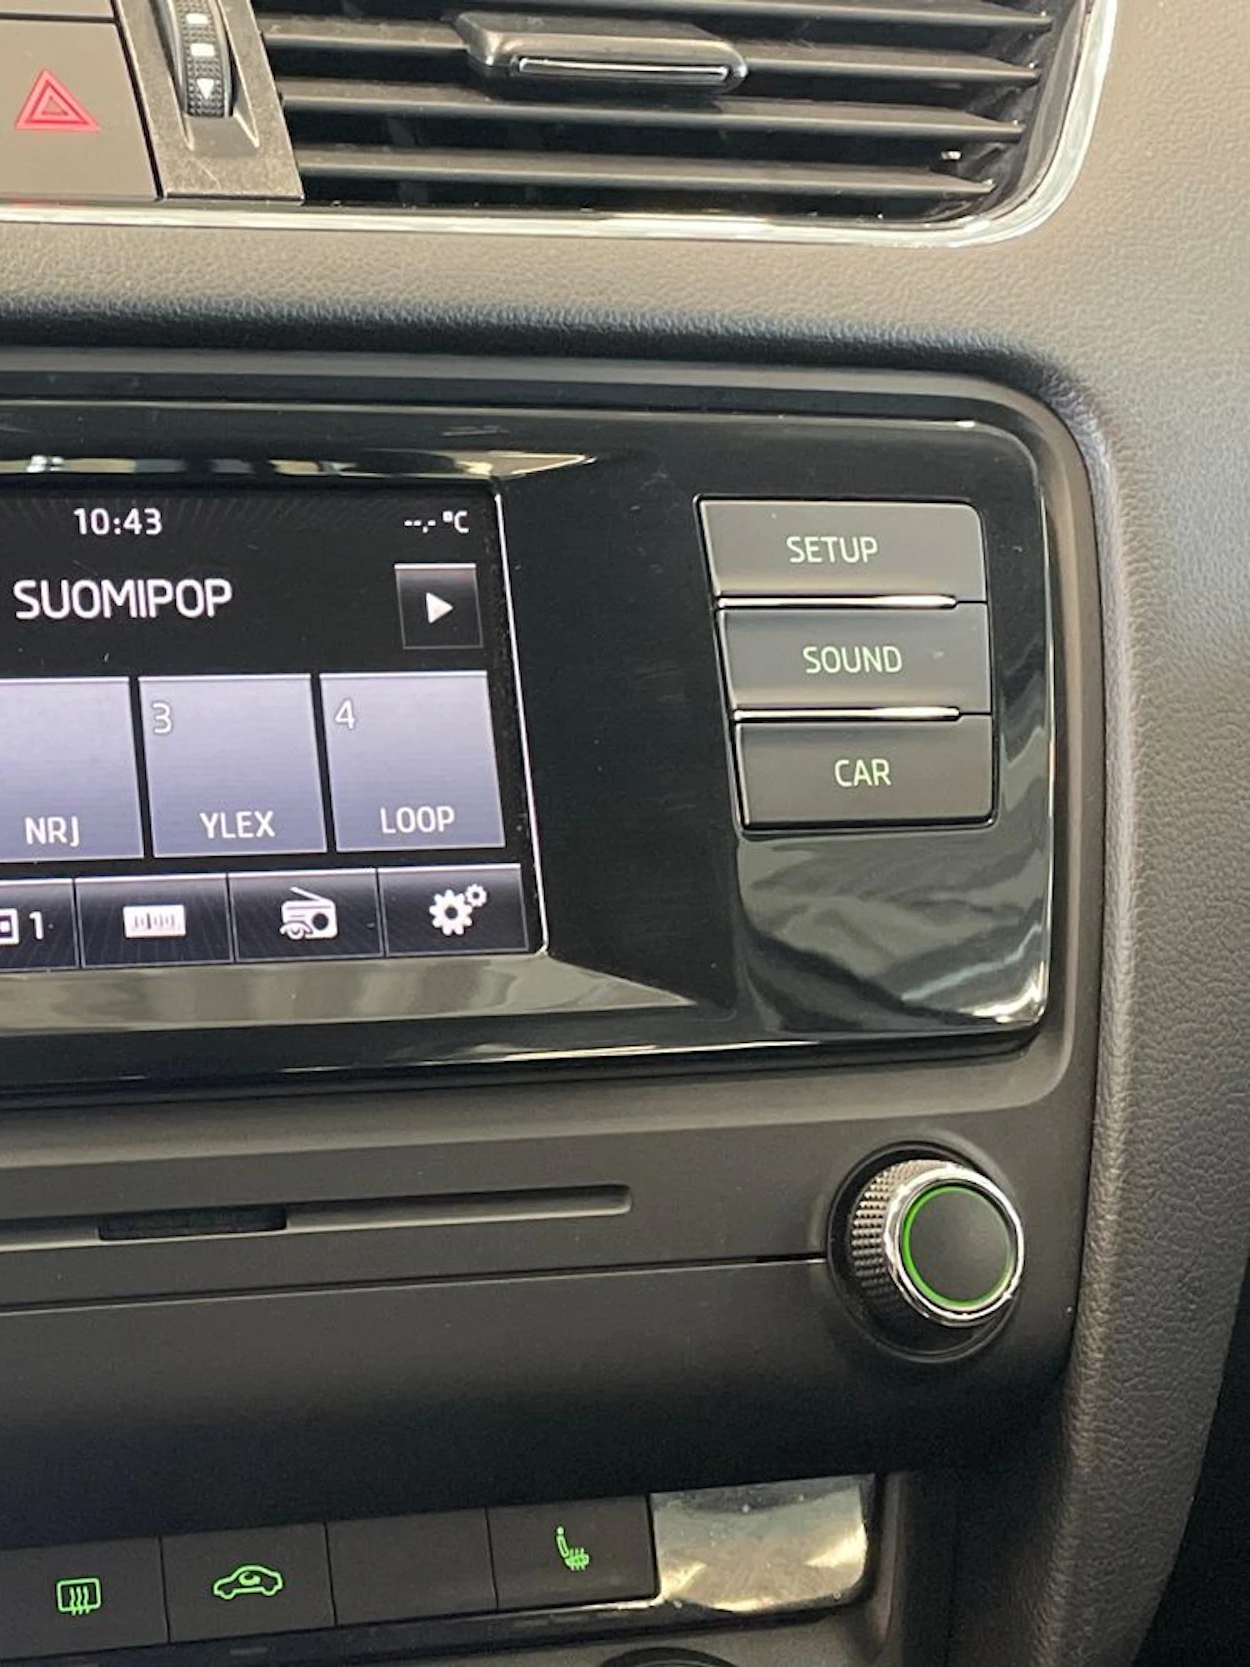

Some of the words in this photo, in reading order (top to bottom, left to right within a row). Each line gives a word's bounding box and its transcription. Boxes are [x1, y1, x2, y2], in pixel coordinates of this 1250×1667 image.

[73, 508, 162, 535] 10:43
[785, 536, 878, 563] SETUP
[12, 577, 233, 620] SUOMIPOP
[802, 646, 902, 673] SOUND
[152, 701, 173, 734] 3
[334, 699, 356, 730] 4
[833, 759, 892, 787] CAR
[24, 816, 80, 848] NRJ
[199, 810, 276, 840] YLEX
[379, 805, 455, 835] LOOP
[28, 911, 43, 940] 1
